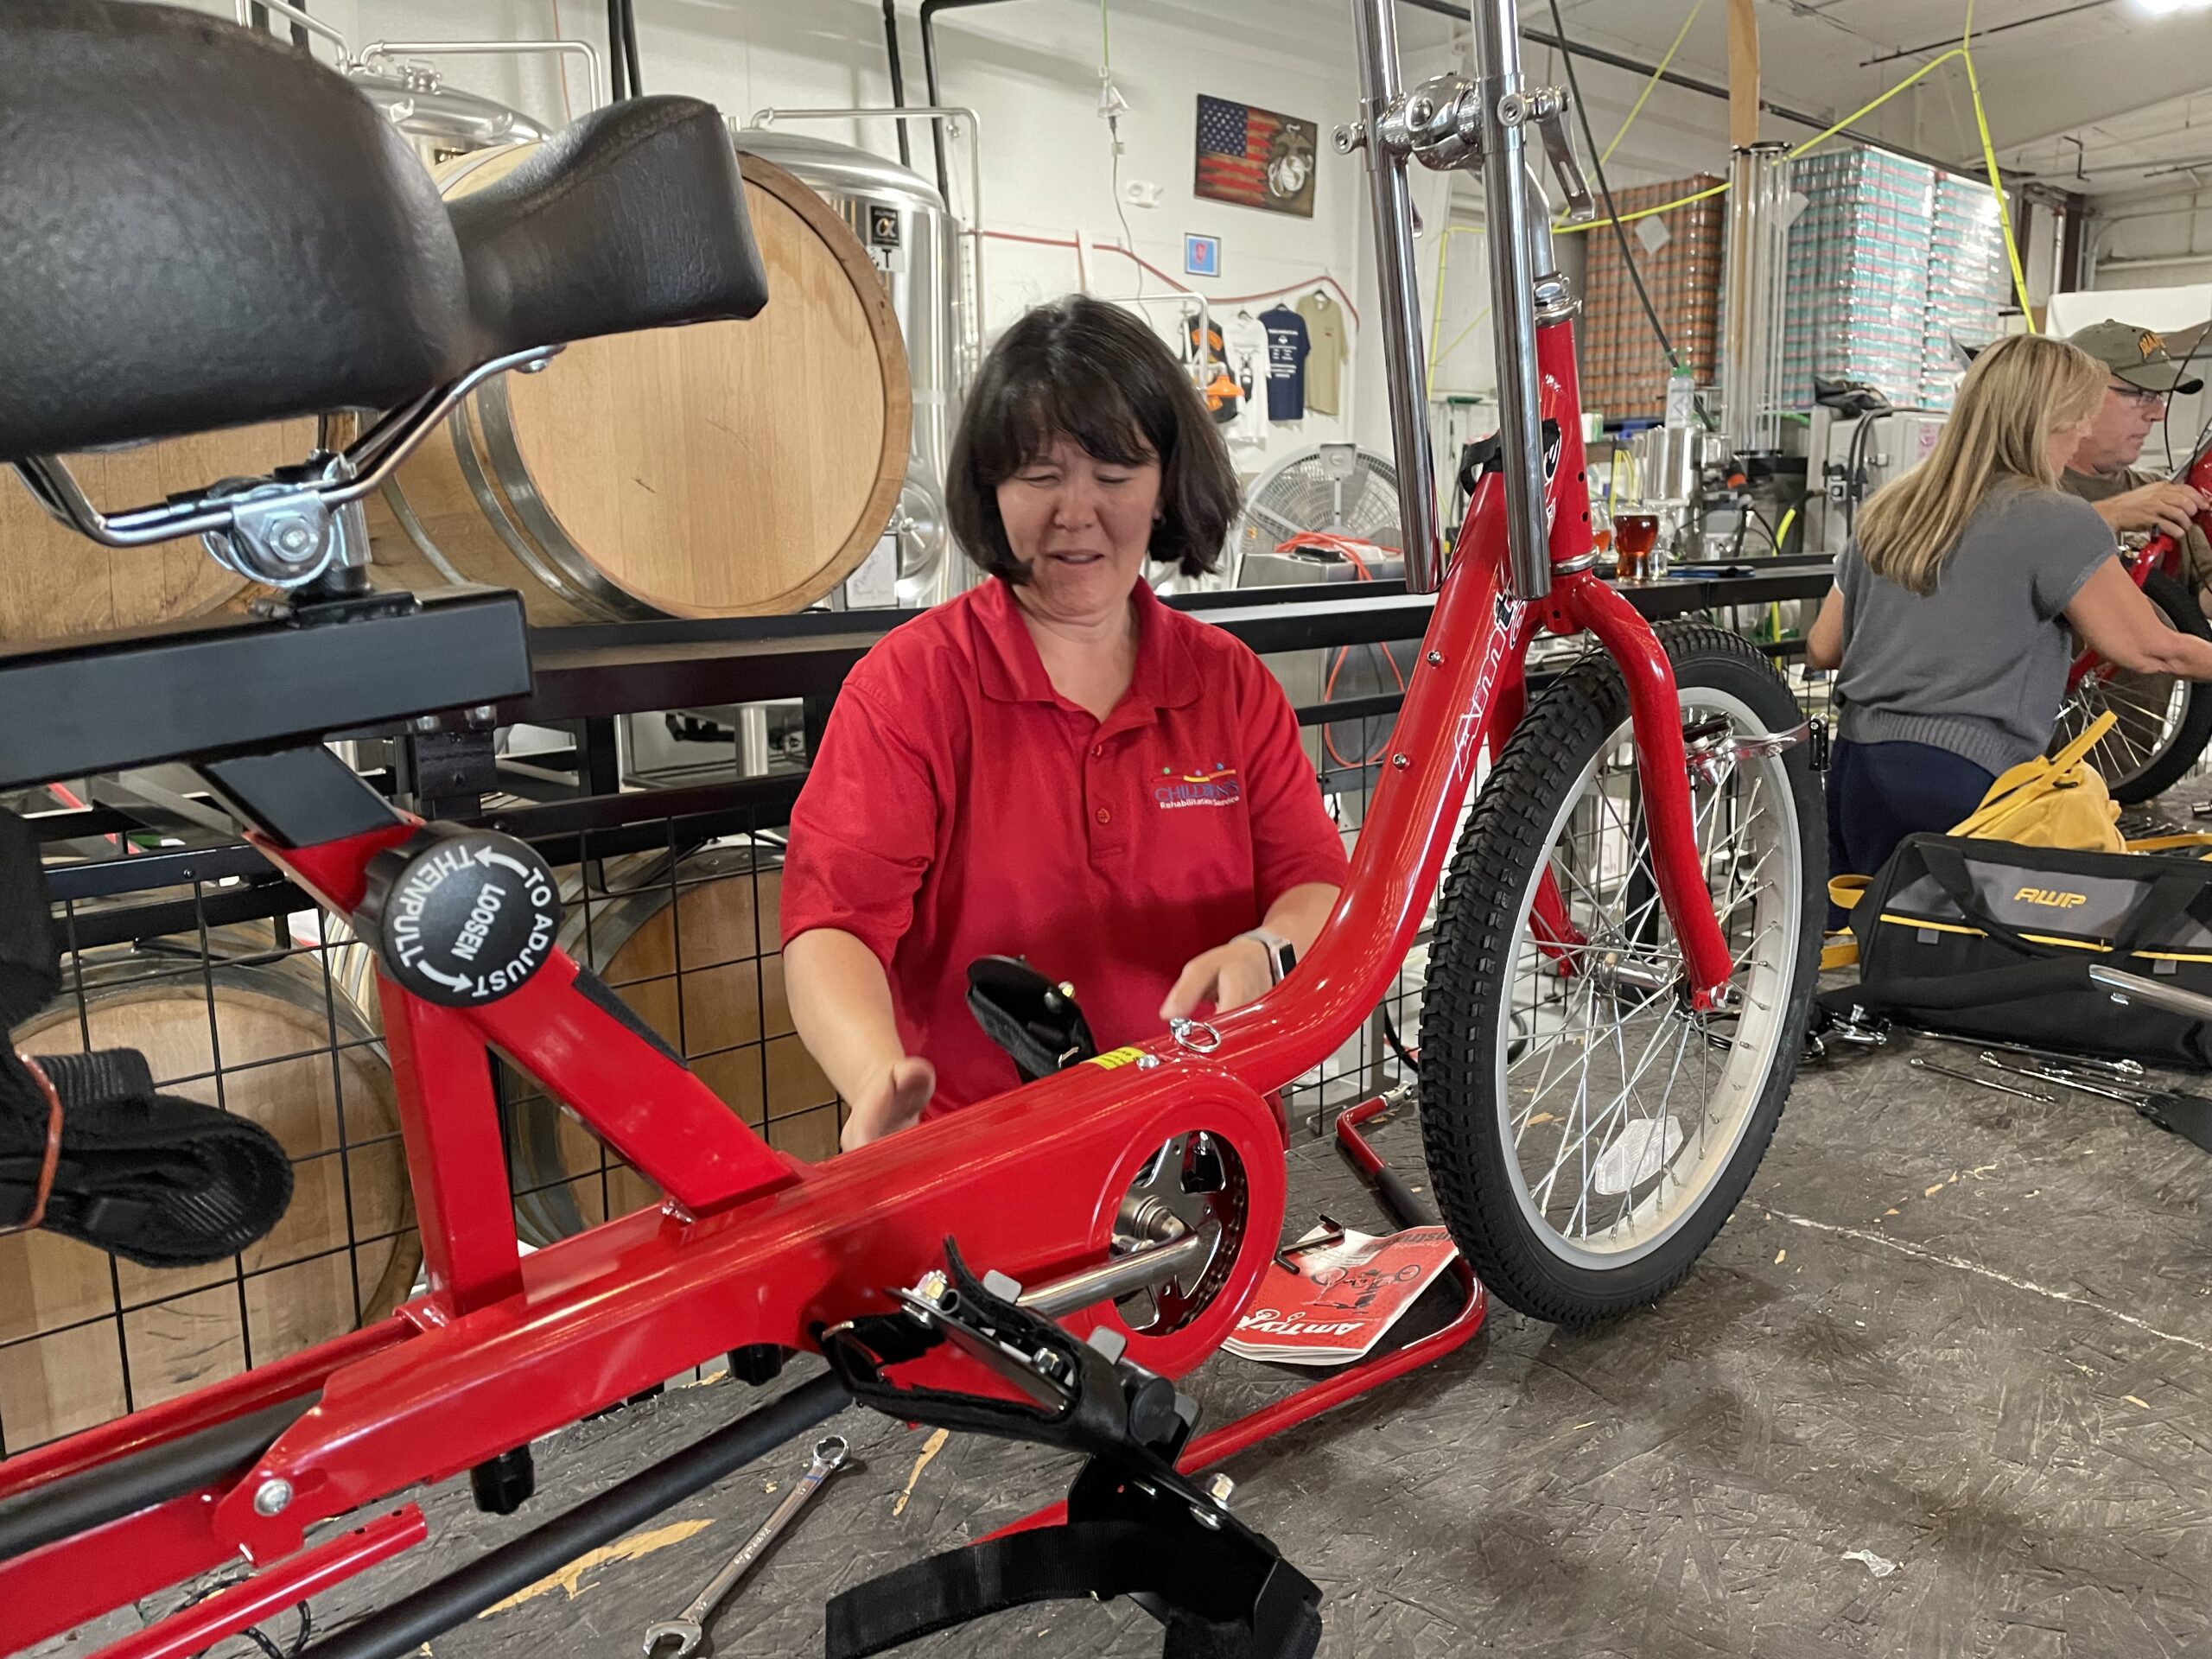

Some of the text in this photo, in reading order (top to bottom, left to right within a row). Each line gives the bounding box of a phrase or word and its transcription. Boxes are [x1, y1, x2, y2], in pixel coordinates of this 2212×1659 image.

[450, 882, 507, 961] LOOSEN
[471, 867, 554, 997] TO ADJUST
[2013, 887, 2087, 908] AWP
